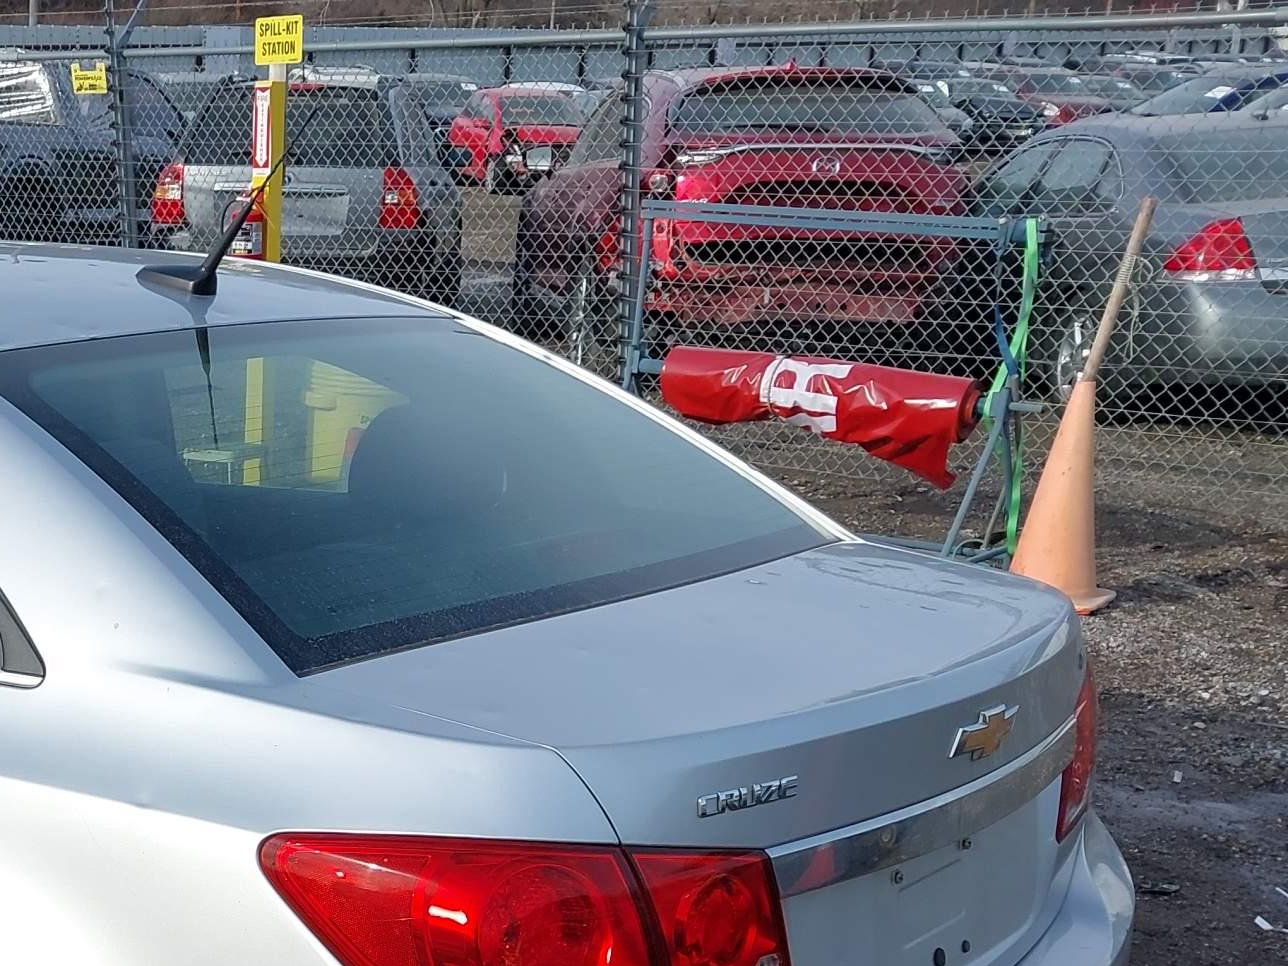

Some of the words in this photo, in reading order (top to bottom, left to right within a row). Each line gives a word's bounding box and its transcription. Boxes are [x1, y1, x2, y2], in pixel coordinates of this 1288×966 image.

[259, 20, 299, 37] SPILL-KIT
[262, 40, 296, 56] STATION
[696, 775, 798, 818] CRUZE
